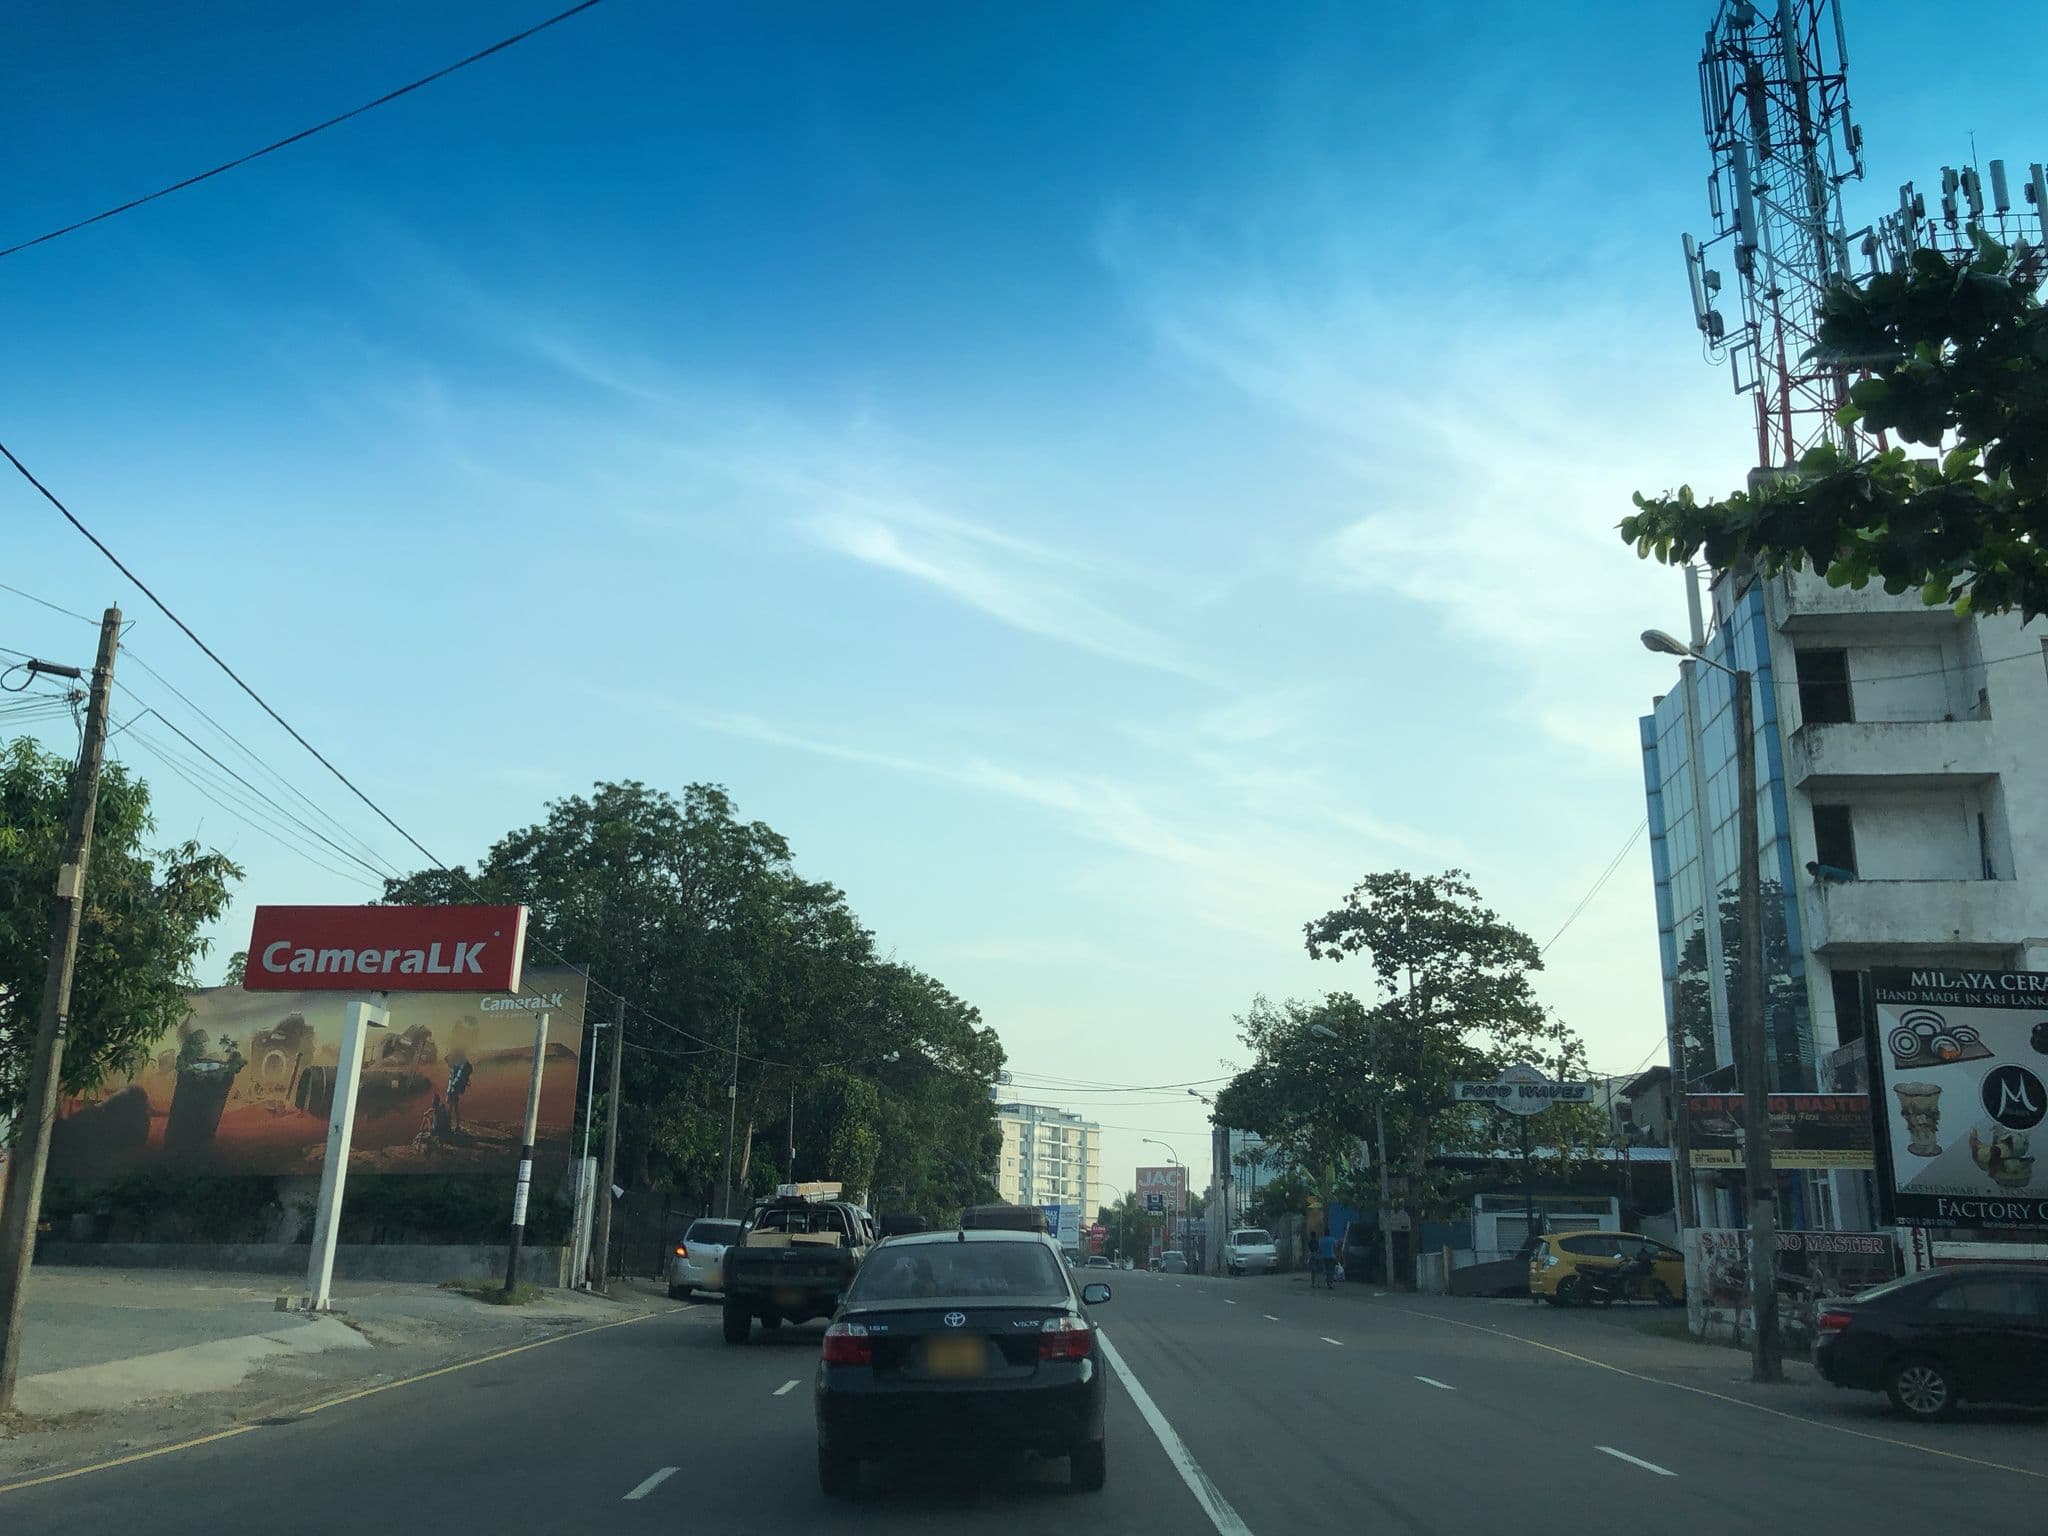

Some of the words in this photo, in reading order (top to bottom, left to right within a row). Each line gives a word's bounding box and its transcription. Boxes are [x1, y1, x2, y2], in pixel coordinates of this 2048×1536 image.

[261, 940, 487, 975] CameraLK
[1910, 971, 1996, 990] MILAYA
[480, 993, 562, 1012] CameraLK
[1461, 1085, 1513, 1099] FOOD
[1518, 1085, 1588, 1099] WAVES
[1937, 1198, 2031, 1220] FACTORY
[1805, 1235, 1885, 1254] MASTER
